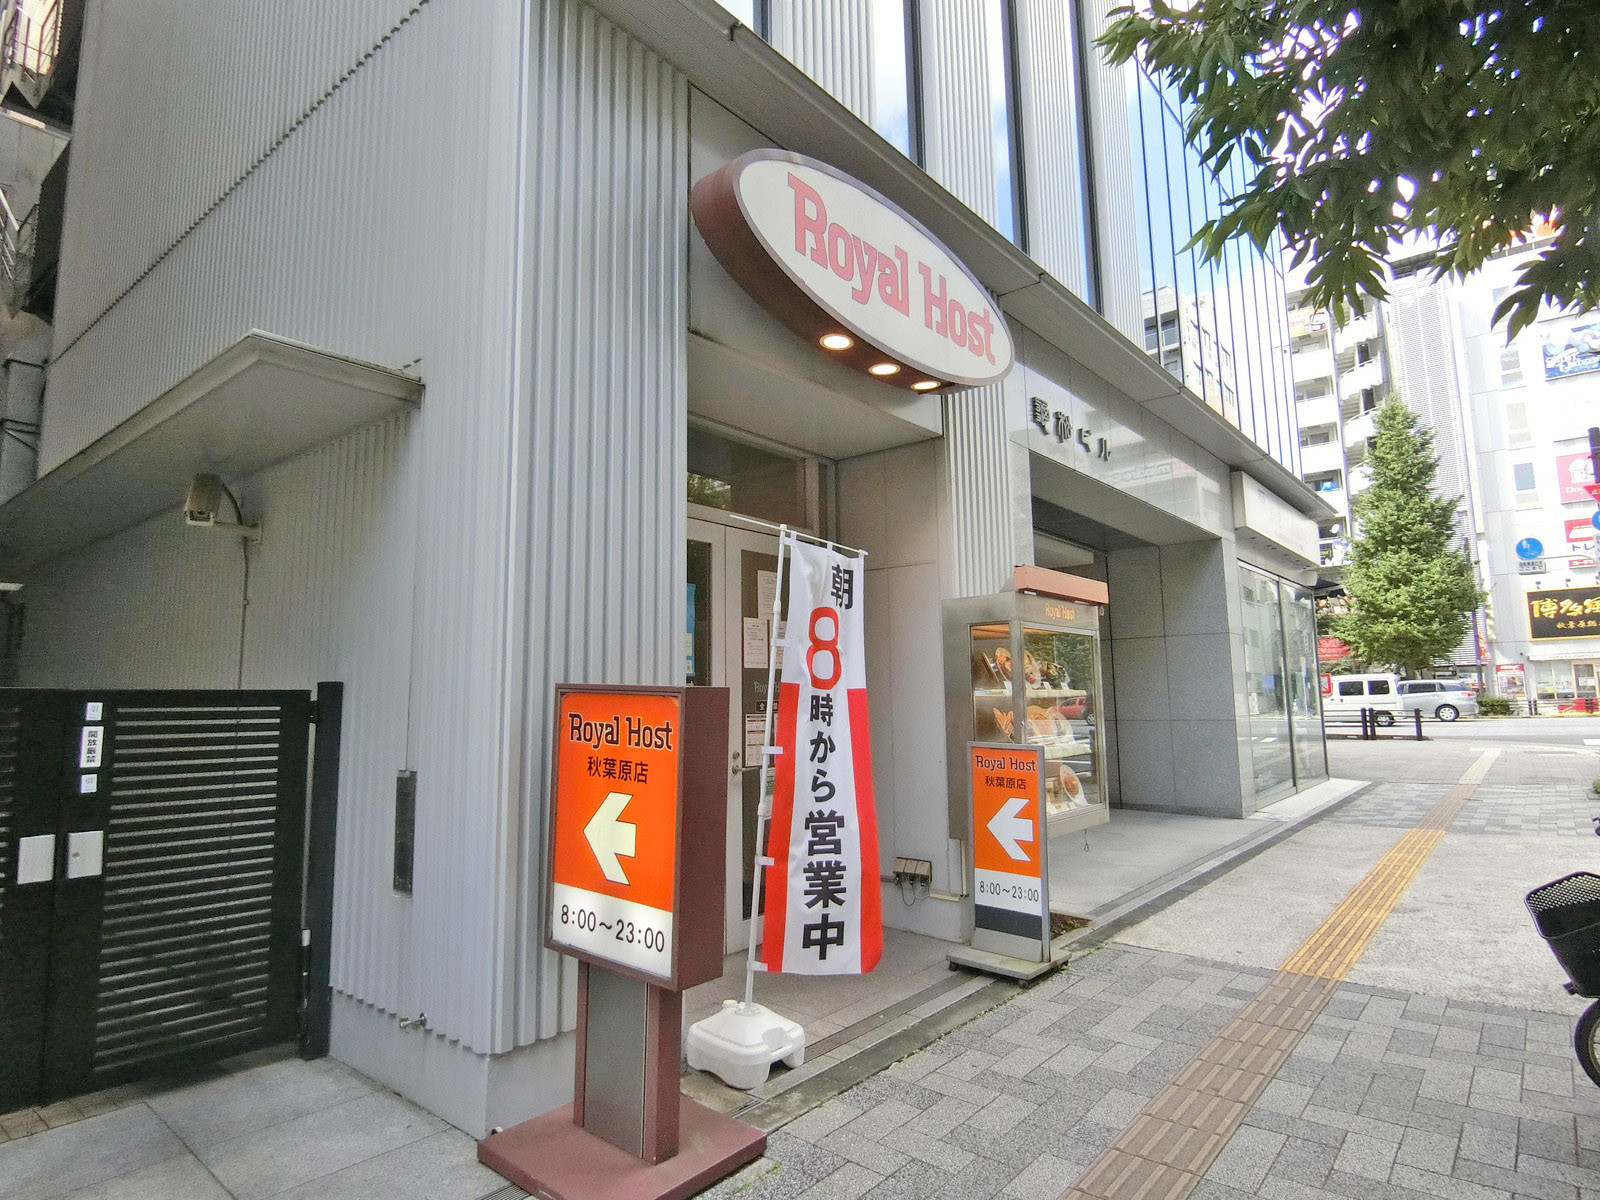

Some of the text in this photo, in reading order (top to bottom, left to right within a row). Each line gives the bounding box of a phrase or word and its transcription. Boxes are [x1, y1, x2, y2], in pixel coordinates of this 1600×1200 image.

[787, 171, 996, 366] Royal Host
[568, 712, 673, 751] Royal Host
[587, 756, 649, 784] 秋葉原店
[975, 755, 1036, 772] Royal Host
[985, 775, 1026, 790] 秋葉原店
